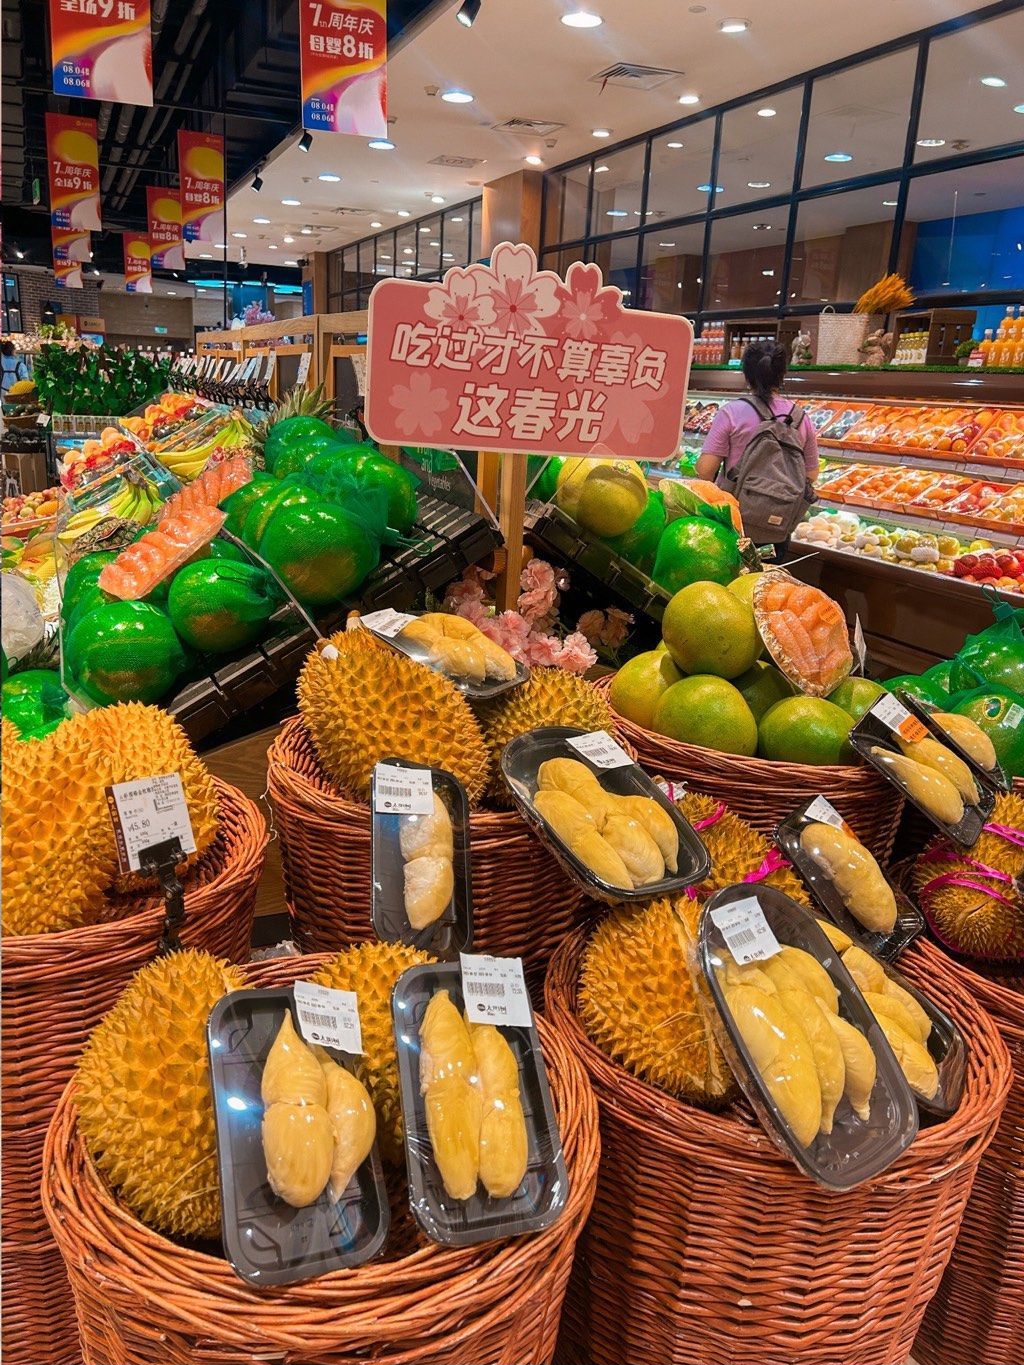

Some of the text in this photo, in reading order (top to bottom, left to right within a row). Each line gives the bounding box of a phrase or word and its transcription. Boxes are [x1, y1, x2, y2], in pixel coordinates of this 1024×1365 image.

[389, 322, 668, 392] 吃过才不算辜负
[451, 382, 607, 443] 这春光
